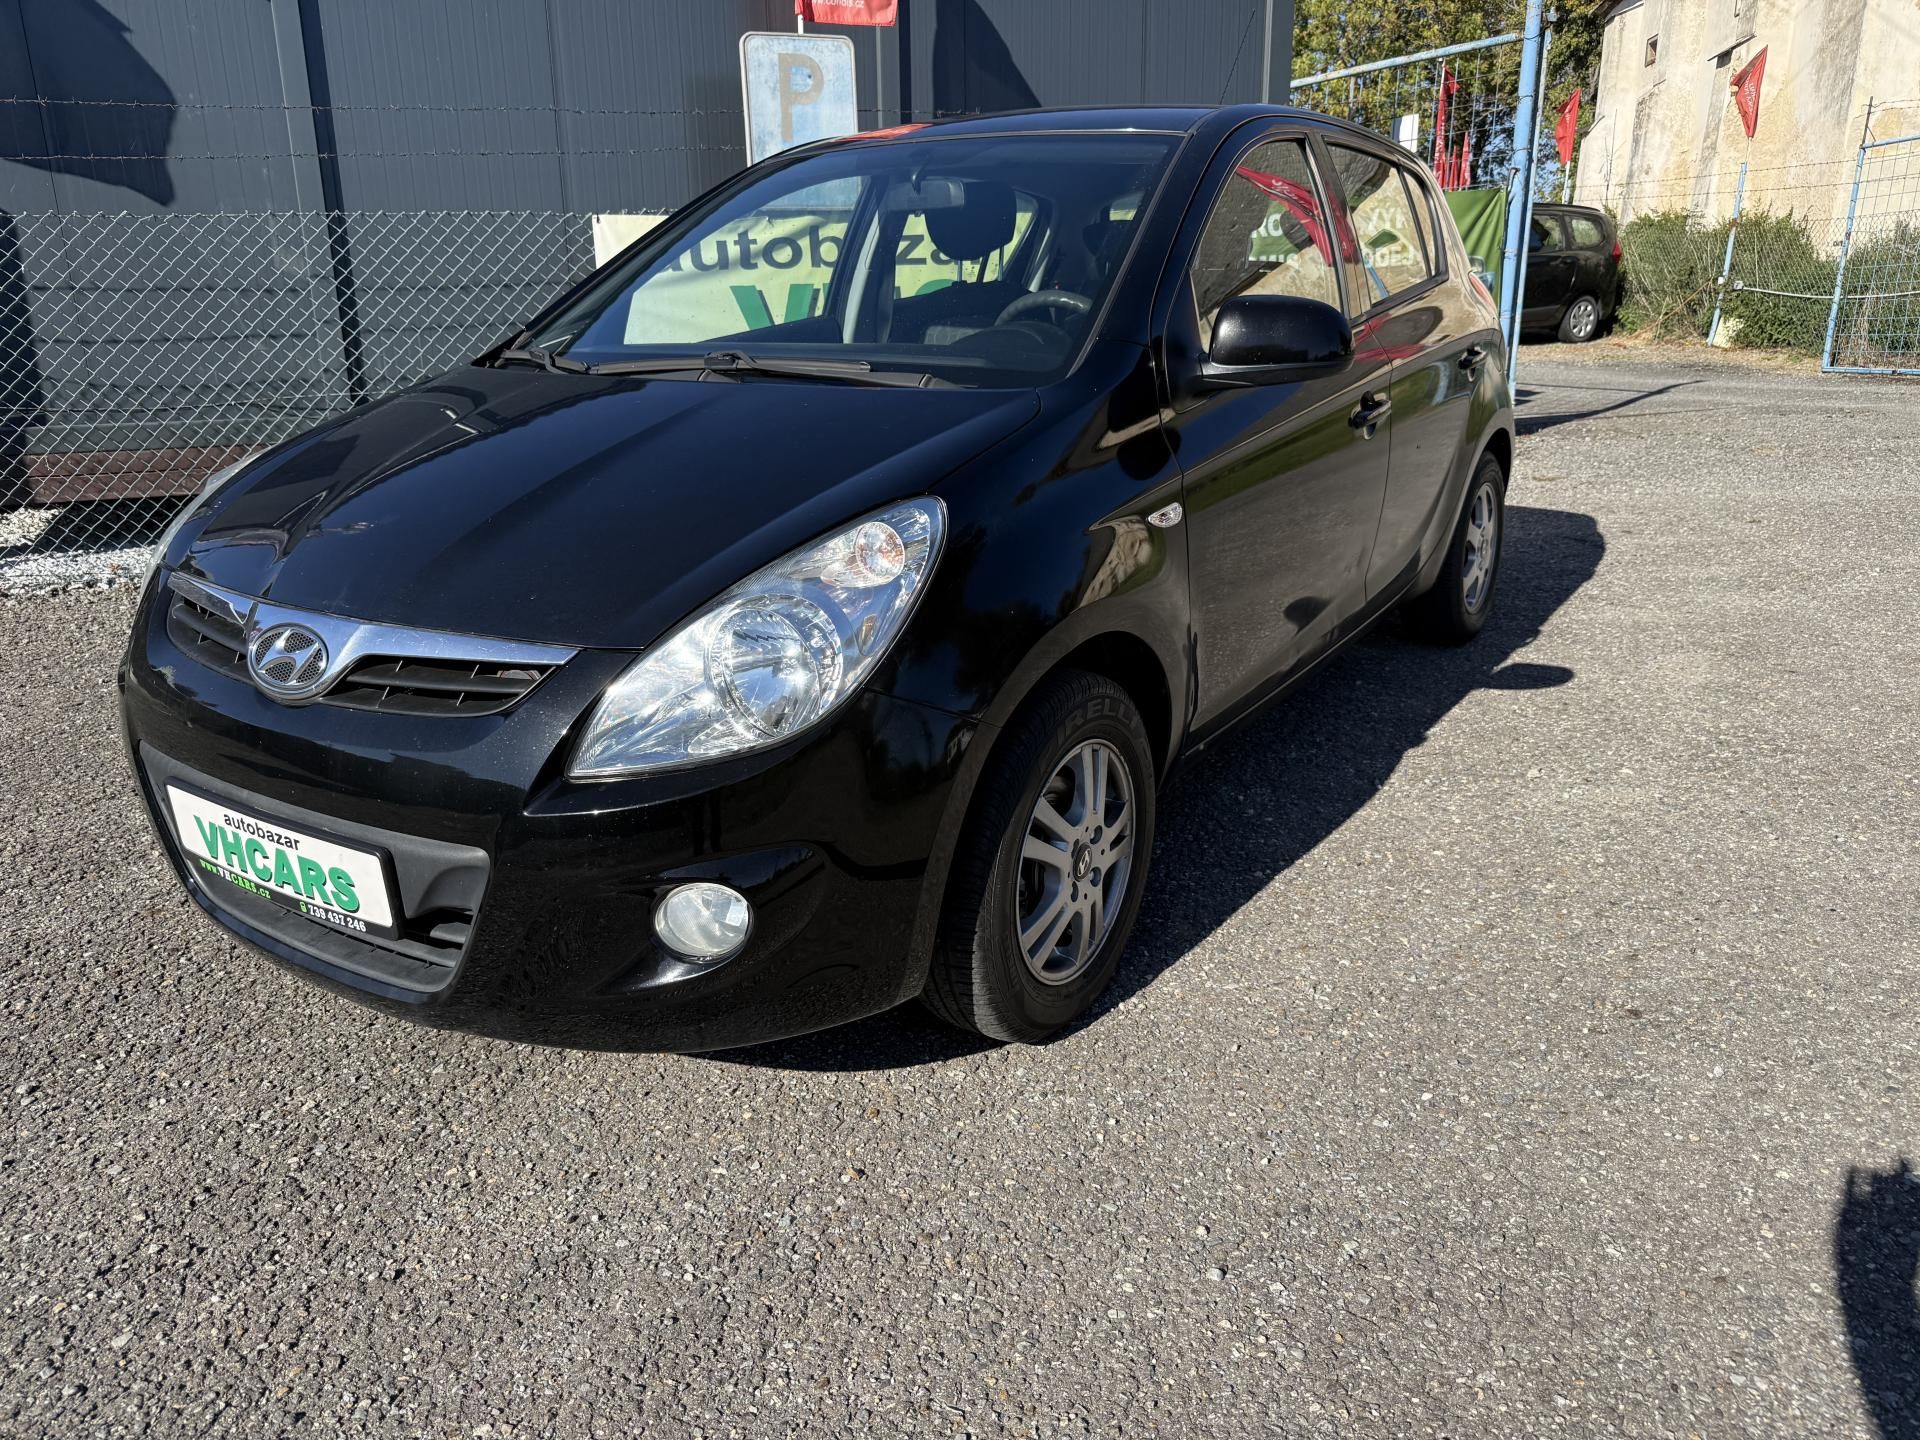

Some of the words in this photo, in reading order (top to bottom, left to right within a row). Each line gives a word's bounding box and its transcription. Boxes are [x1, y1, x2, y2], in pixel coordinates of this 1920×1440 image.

[778, 53, 824, 142] P
[223, 813, 300, 850] autobazar
[193, 814, 360, 914] VHCARS
[308, 904, 326, 920] 739
[327, 911, 345, 926] 437
[347, 917, 367, 932] 246
